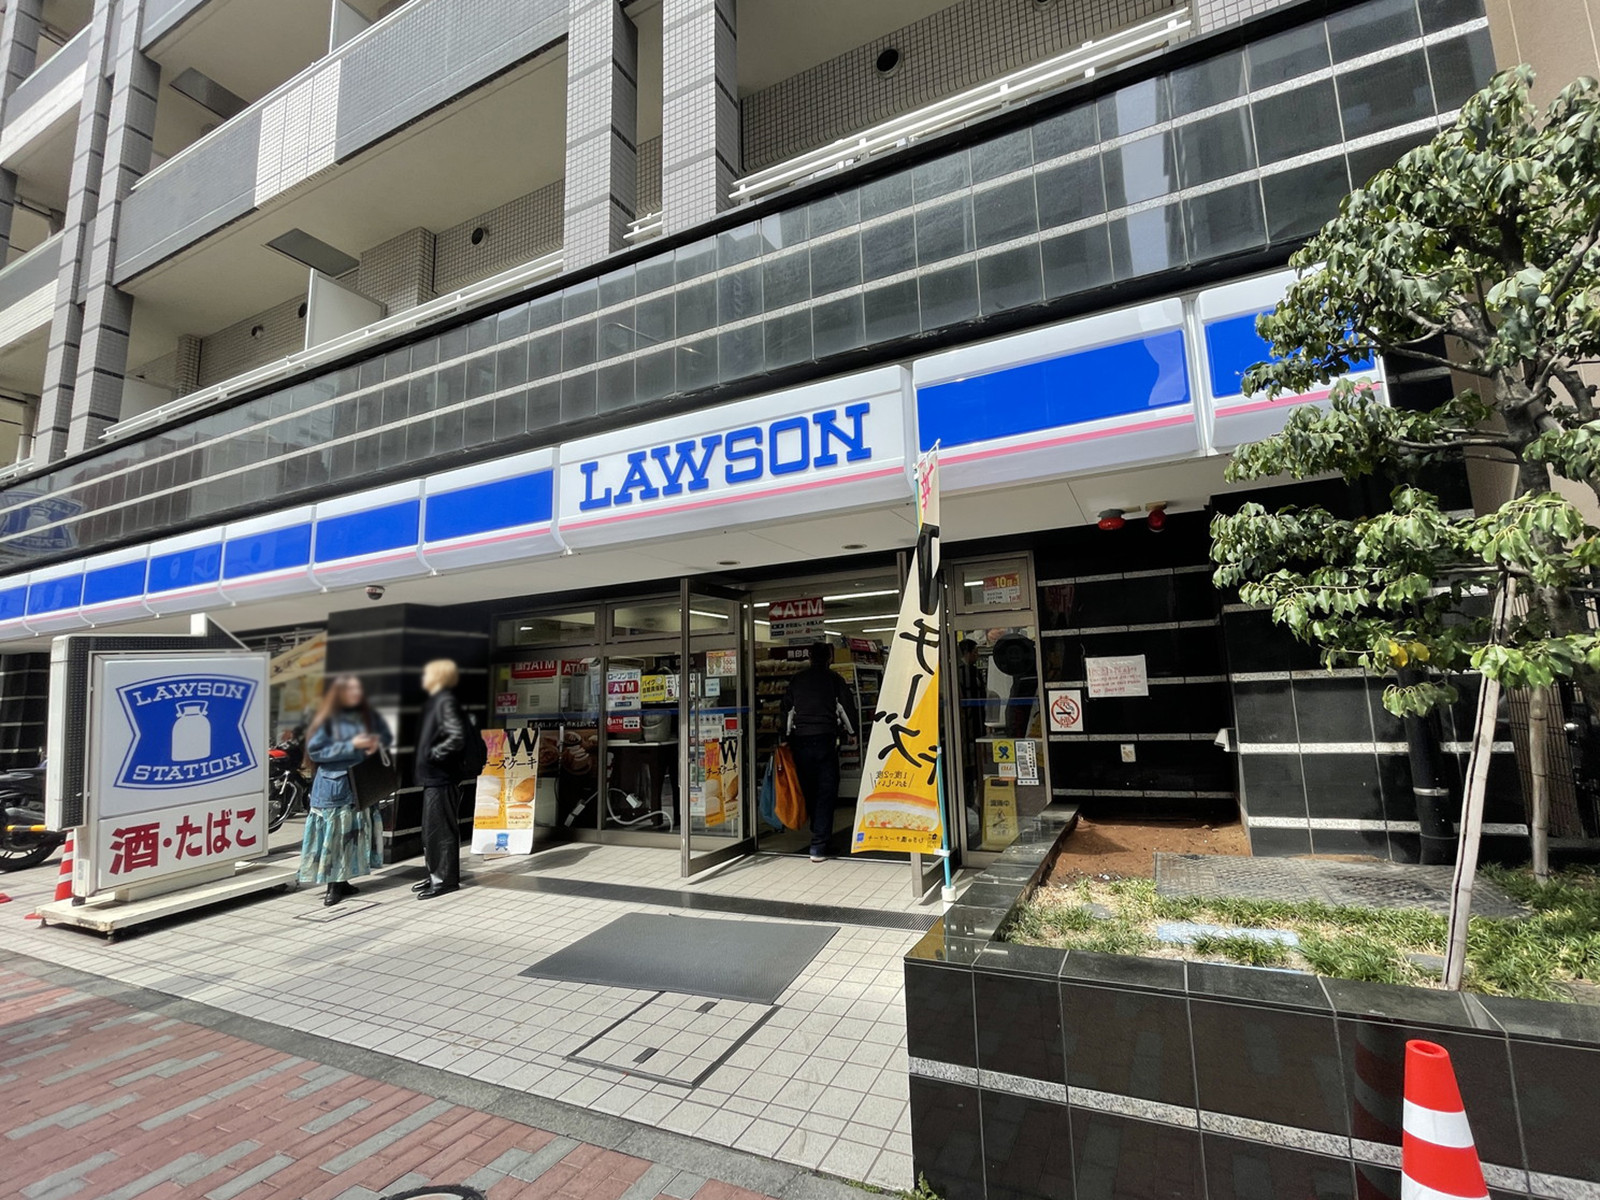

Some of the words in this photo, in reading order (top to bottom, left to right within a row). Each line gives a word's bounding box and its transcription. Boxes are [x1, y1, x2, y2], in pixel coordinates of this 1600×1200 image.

[580, 402, 872, 511] LAWSON
[783, 599, 823, 618] ATM
[787, 649, 812, 659] 無印良
[132, 682, 246, 707] LAWSON
[613, 682, 635, 693] ATM
[132, 753, 244, 781] STATION
[485, 756, 538, 770] ーズケーキ
[109, 808, 257, 875] 酒・たばこ
